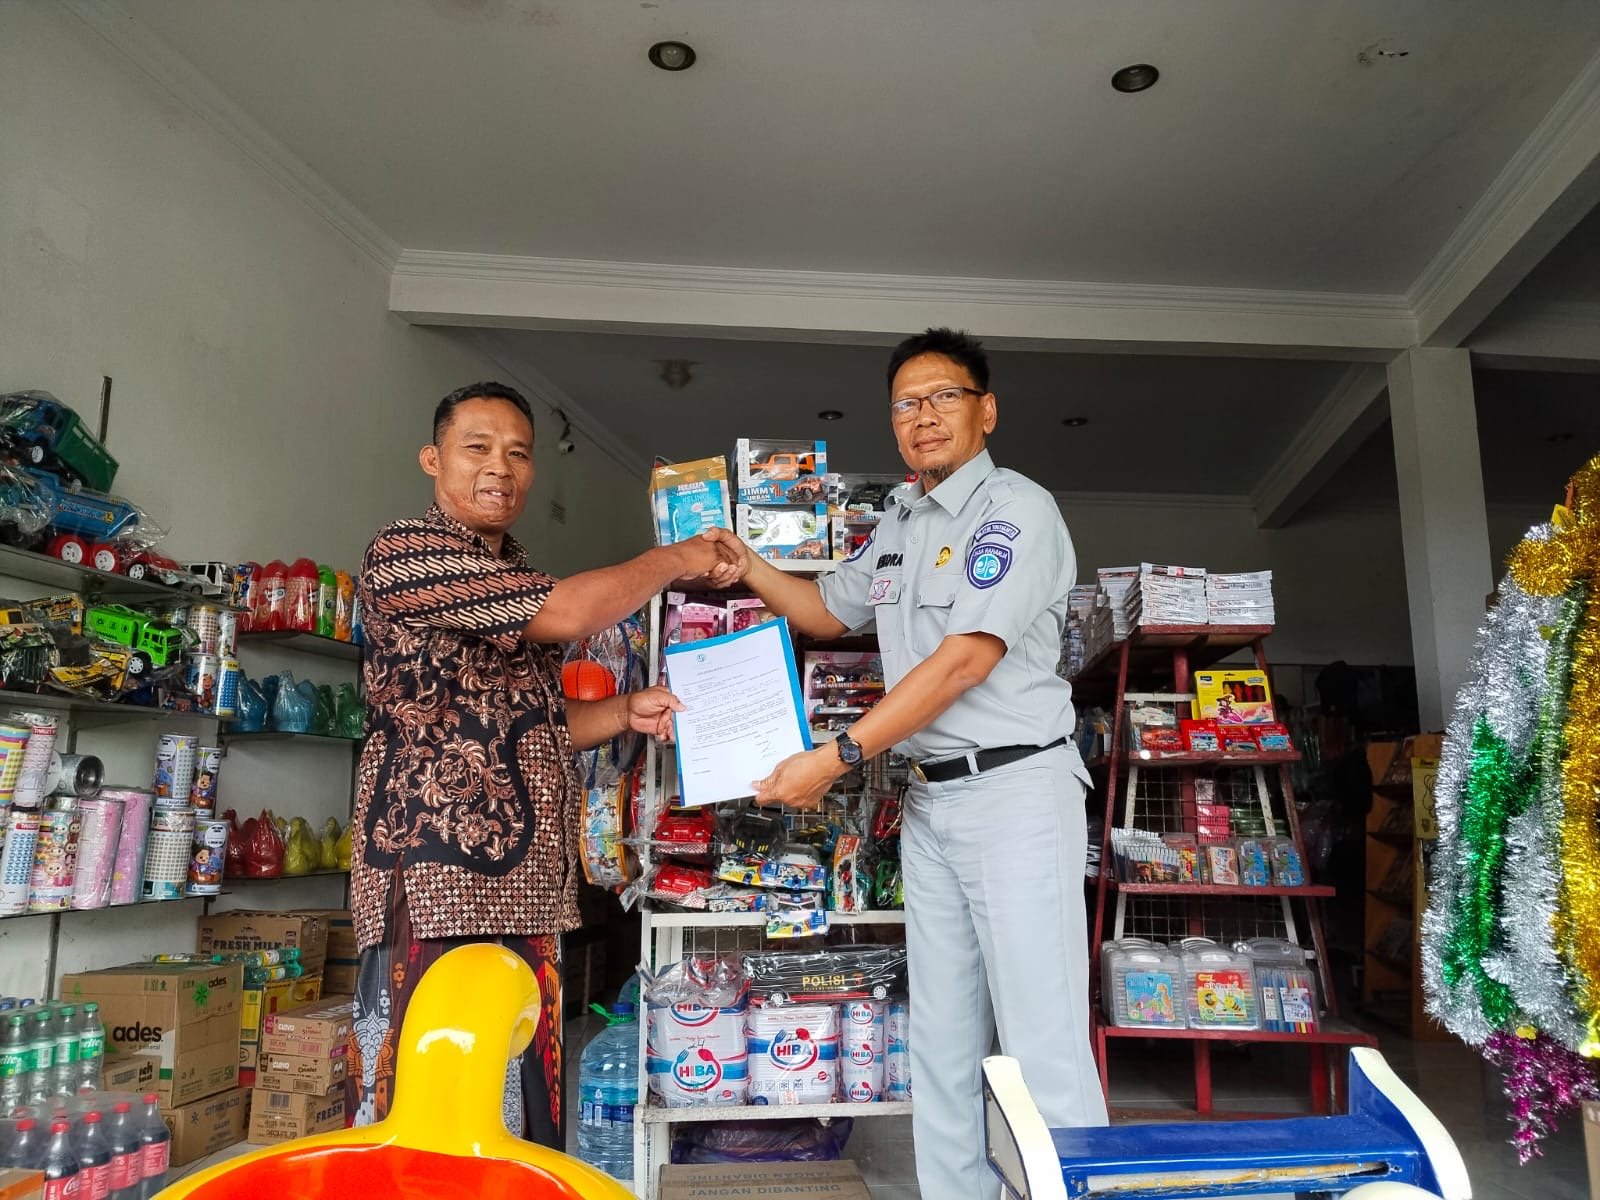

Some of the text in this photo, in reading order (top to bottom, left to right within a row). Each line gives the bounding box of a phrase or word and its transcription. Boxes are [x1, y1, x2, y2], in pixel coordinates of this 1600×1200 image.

[741, 487, 775, 496] JIMMY
[213, 939, 283, 951] FRESH MILK
[208, 975, 227, 989] ades
[802, 974, 845, 987] POLISI
[113, 1021, 162, 1042] ades
[776, 1044, 812, 1057] HIBA
[679, 1065, 716, 1078] HIBA
[851, 1089, 871, 1097] HIBA
[316, 1102, 343, 1123] FRESH
[689, 1184, 841, 1197] JANGAN DIBANTING
